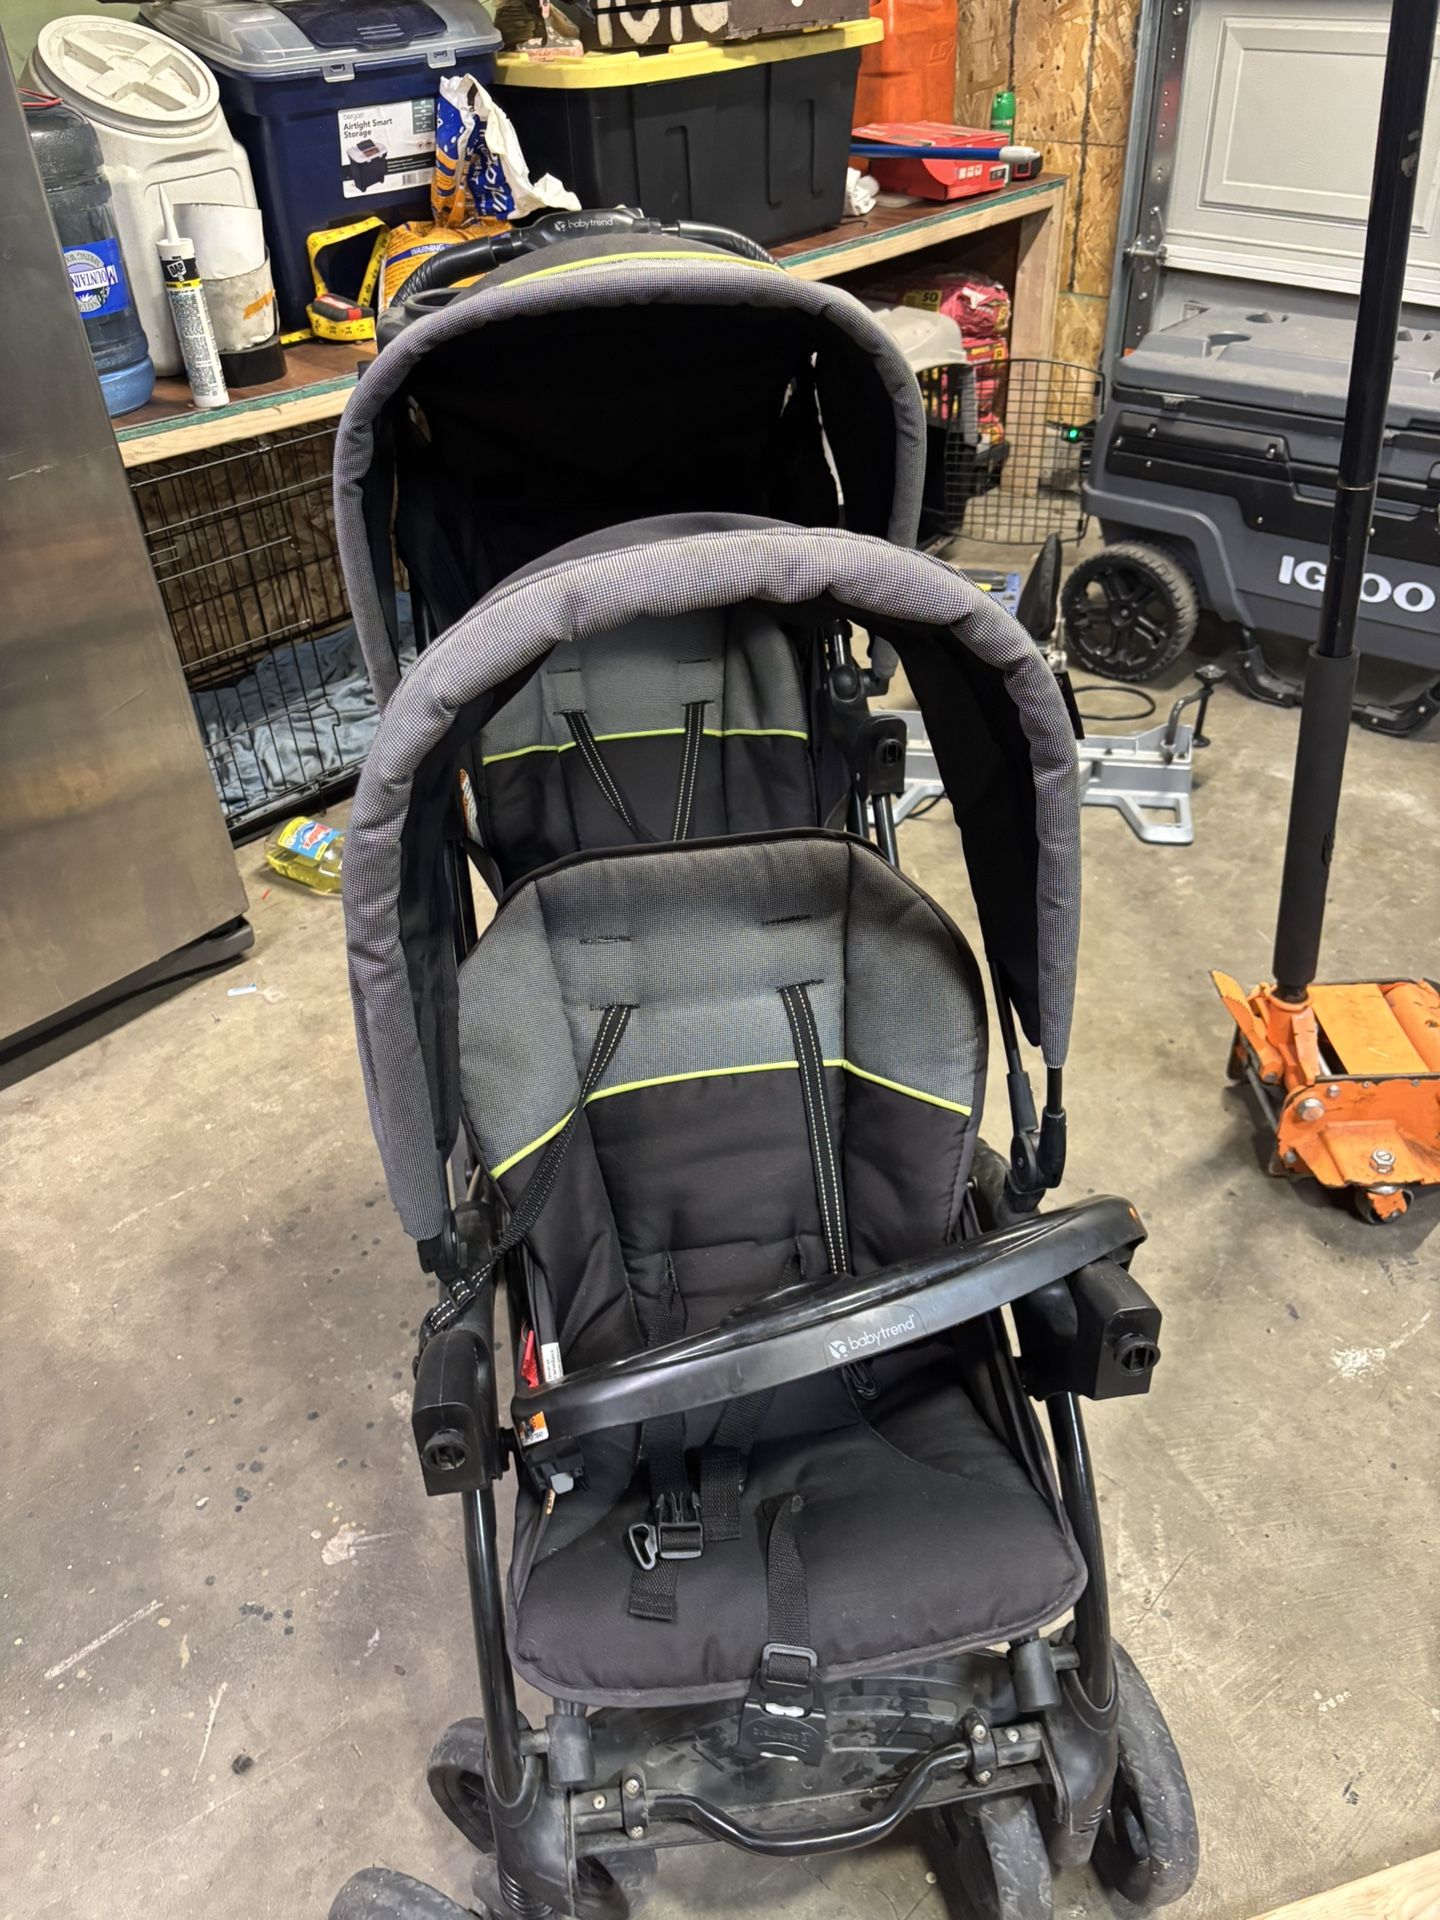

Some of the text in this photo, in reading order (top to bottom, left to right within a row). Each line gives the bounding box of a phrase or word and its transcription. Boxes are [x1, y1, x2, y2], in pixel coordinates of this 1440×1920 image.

[343, 118, 393, 131] Airtight Smart
[343, 130, 372, 139] Storage
[567, 218, 613, 229] babytrend
[410, 244, 446, 256] WARNING
[169, 262, 184, 277] DAP
[1278, 555, 1436, 612] IGOO
[847, 1314, 916, 1350] babytrend
